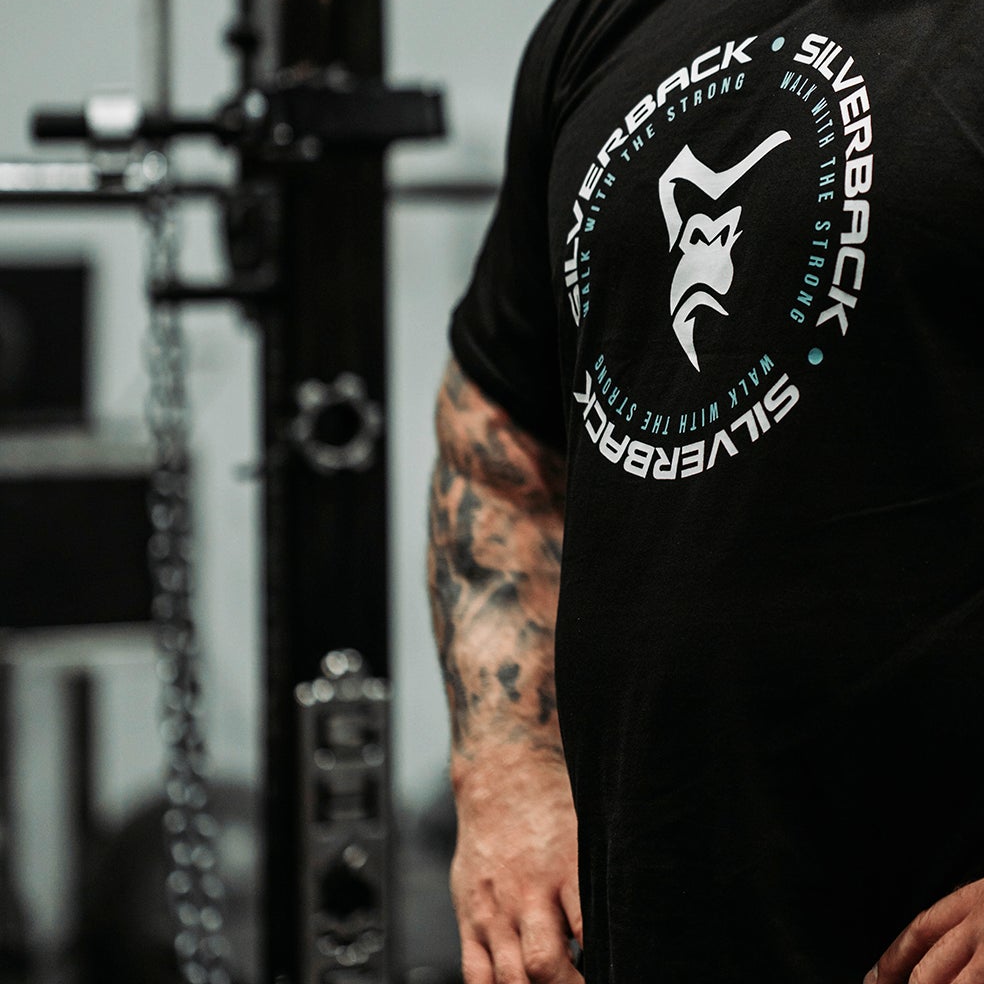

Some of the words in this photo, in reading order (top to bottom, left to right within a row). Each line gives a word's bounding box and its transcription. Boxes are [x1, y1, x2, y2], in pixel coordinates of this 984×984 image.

[666, 72, 746, 122] STRONG
[780, 71, 818, 102] WALK
[620, 123, 656, 162] THE
[811, 97, 835, 148] WITH
[564, 36, 759, 328] SILVERBACK
[584, 173, 616, 233] WITH
[793, 33, 874, 337] SILVERBACK
[818, 156, 837, 203] THE
[580, 249, 591, 318] WALK
[789, 220, 831, 324] STRONG
[594, 354, 638, 423] STRONG
[728, 354, 775, 409] WALK
[572, 370, 801, 480] SILVERBACK
[640, 411, 671, 436] THE
[678, 402, 720, 434] WITH
